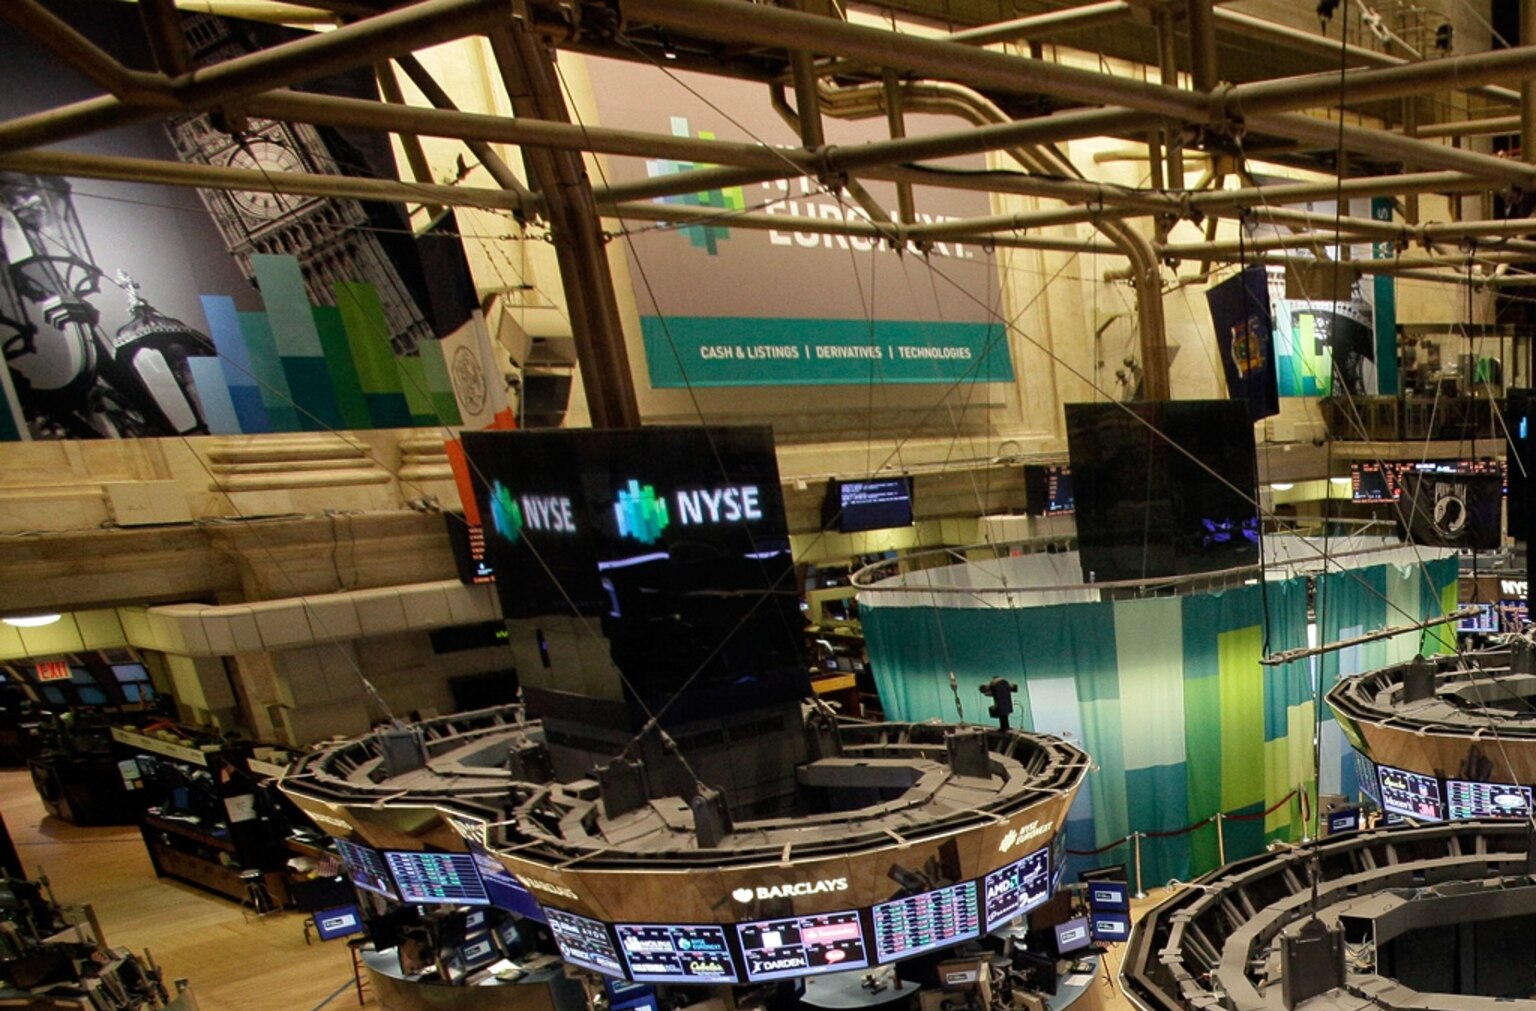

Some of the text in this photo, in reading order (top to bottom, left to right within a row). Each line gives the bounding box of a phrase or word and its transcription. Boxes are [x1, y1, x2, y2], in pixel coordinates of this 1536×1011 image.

[700, 346, 971, 360] CASH & LISTINGS DERIVATIVES TECHNOLOGIES
[522, 495, 576, 533] NYSE
[676, 485, 763, 526] NYSE
[756, 877, 849, 901] BARCLAYS
[764, 956, 805, 972] DARDEN
